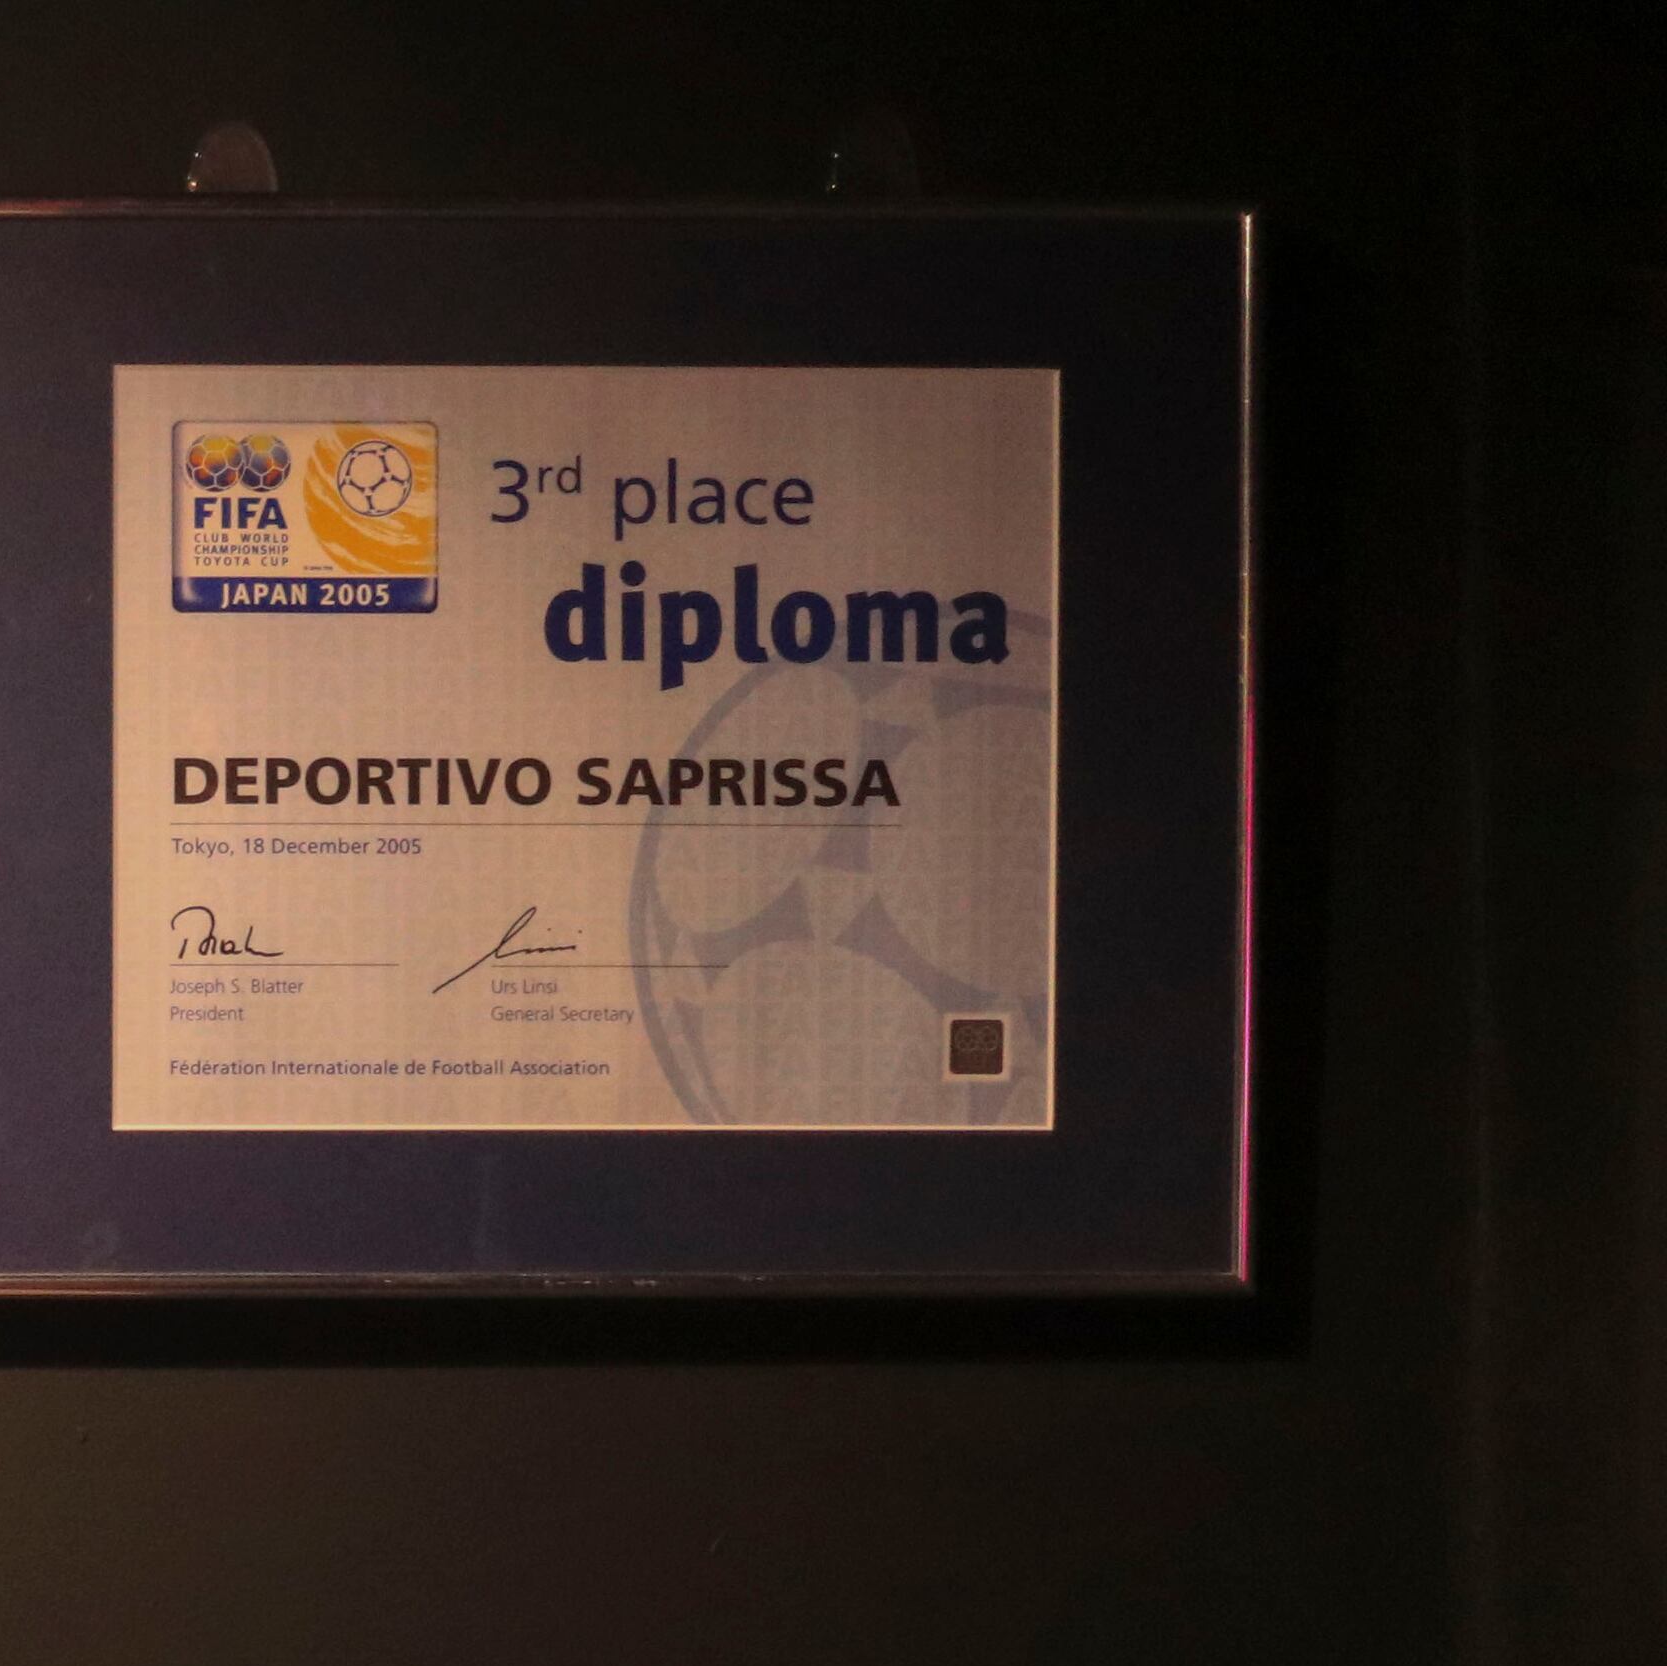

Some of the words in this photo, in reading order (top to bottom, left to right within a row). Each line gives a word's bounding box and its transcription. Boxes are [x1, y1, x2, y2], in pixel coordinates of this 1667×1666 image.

[488, 453, 585, 526] 3rd
[613, 456, 817, 539] place
[193, 496, 289, 530] FIFA
[194, 534, 230, 544] CLUB
[240, 534, 289, 544] WORLD
[194, 545, 289, 555] CHAMPIONSHIP
[194, 556, 251, 567] TOYOTA
[260, 556, 289, 567] CUP
[221, 583, 307, 609] JAPAN
[319, 583, 390, 607] 2005
[543, 560, 1012, 691] diploma
[171, 755, 553, 808] DEPORTIVO
[575, 755, 902, 808] SAPRISSA
[171, 838, 235, 857] Tokyo,
[244, 838, 265, 855] 18
[271, 837, 370, 855] December
[375, 837, 423, 855] 2005
[169, 978, 225, 1000] Joseph
[231, 978, 246, 995] S.
[251, 977, 305, 995] Blatter
[491, 978, 515, 995] Urs
[523, 977, 559, 995] Linsi
[170, 1004, 245, 1022] President
[491, 1005, 555, 1022] General
[560, 1005, 635, 1027] Secretary
[170, 1058, 266, 1077] Fédération
[271, 1058, 399, 1077] Internationale
[405, 1057, 427, 1076] de
[432, 1057, 505, 1076] Football
[510, 1057, 611, 1077] Association
